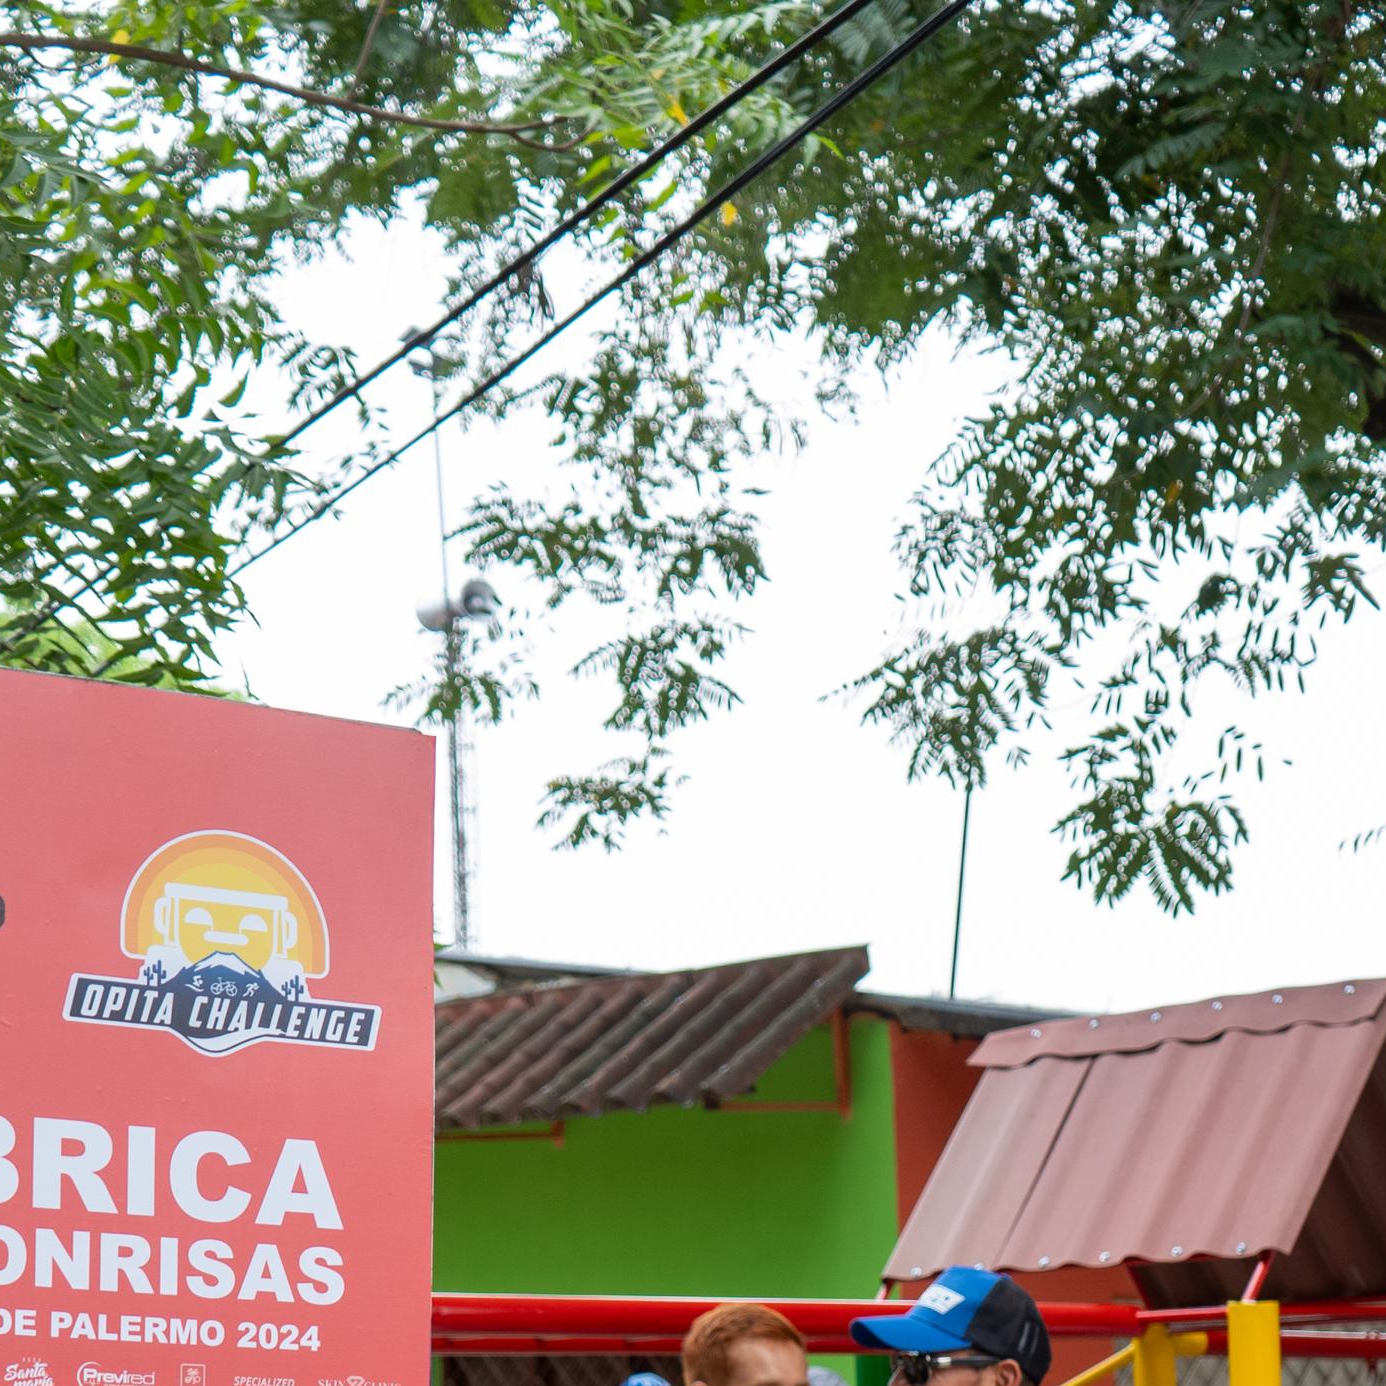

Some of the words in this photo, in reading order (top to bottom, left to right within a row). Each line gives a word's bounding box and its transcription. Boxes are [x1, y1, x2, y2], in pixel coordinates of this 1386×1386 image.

[80, 984, 174, 1025] OPITA
[188, 995, 365, 1043] CHALLENGE
[51, 1311, 225, 1347] PALERMO
[237, 1322, 321, 1352] 2024
[4, 1361, 49, 1382] Santa
[83, 1368, 155, 1385] Previred
